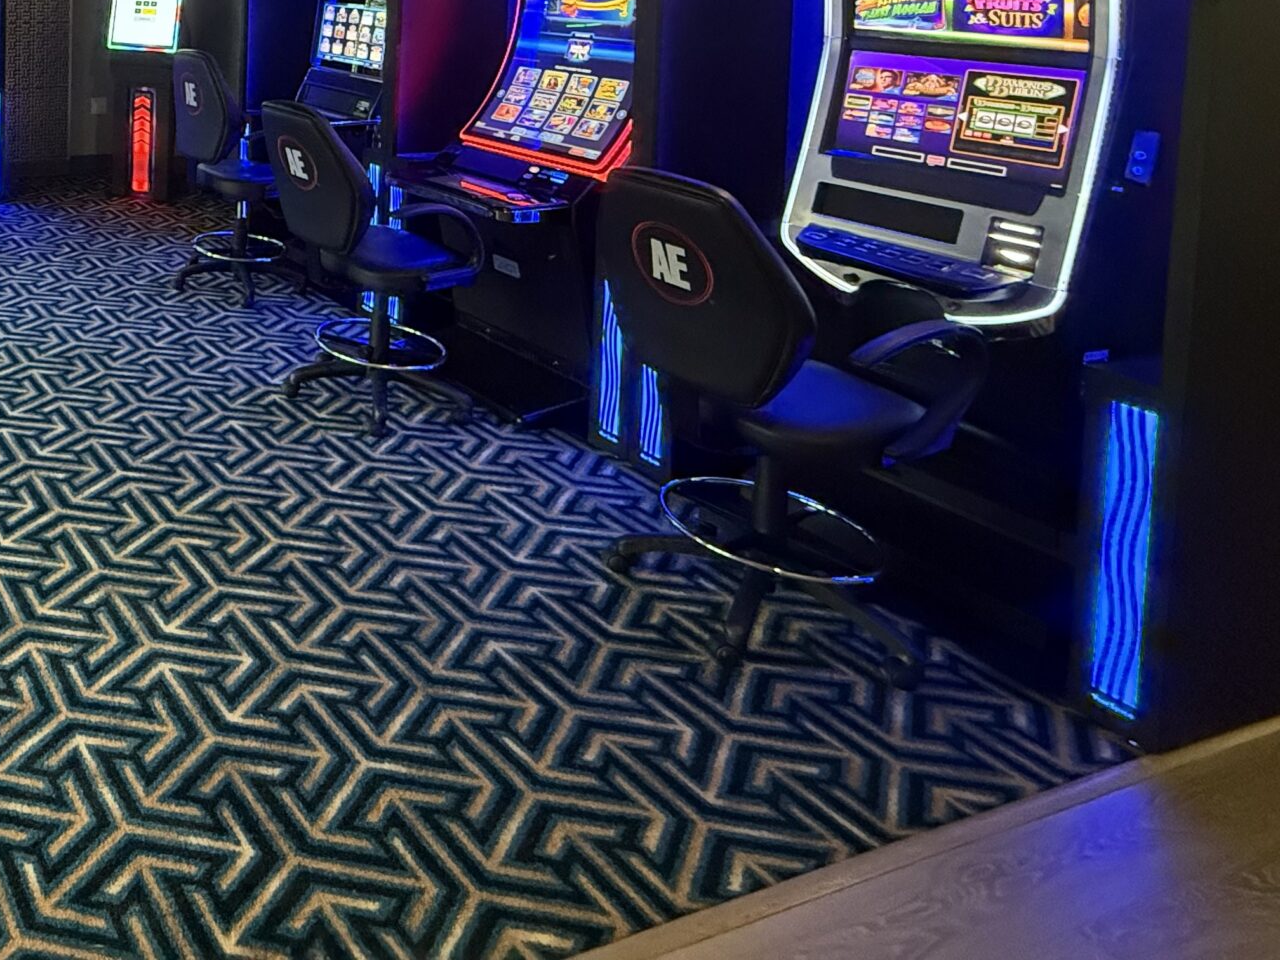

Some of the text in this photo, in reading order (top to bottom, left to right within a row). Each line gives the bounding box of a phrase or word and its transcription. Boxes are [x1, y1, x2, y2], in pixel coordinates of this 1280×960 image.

[987, 10, 1044, 28] SUITS
[185, 81, 197, 107] AE
[285, 147, 309, 180] AE
[650, 238, 691, 291] AE
